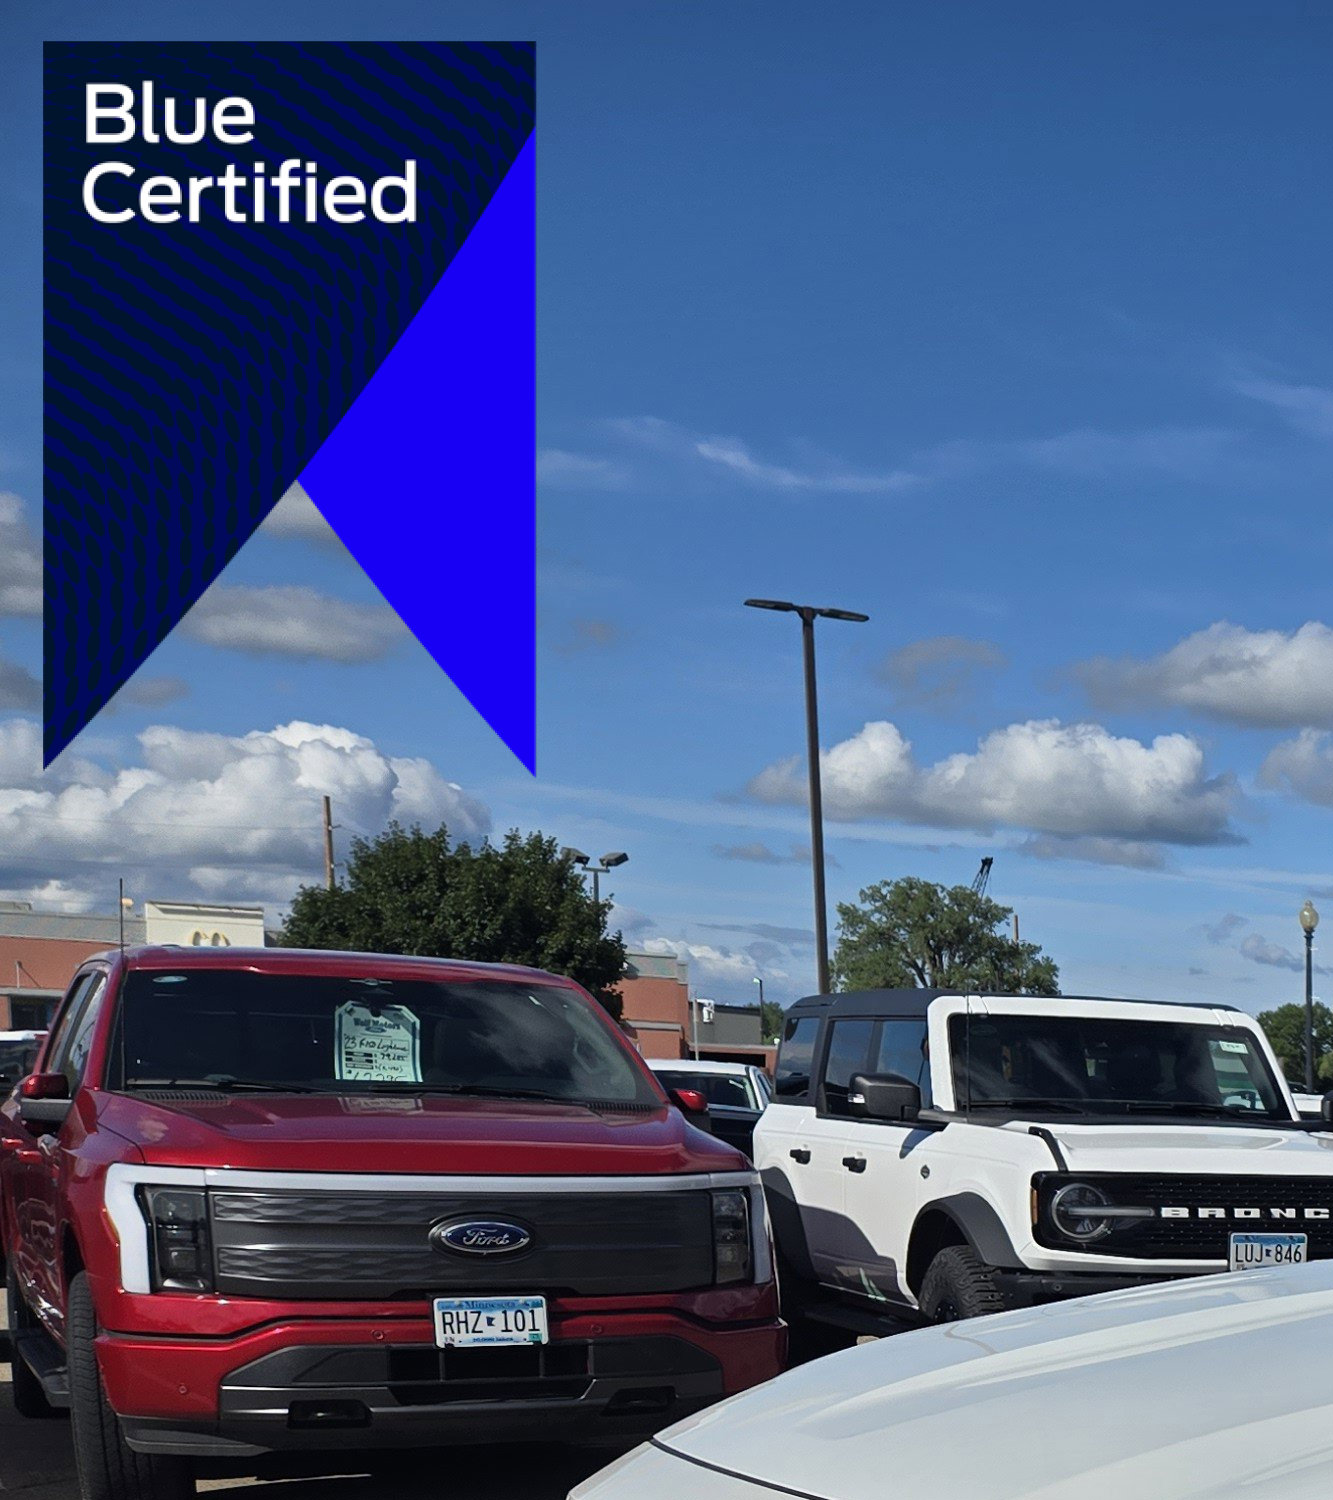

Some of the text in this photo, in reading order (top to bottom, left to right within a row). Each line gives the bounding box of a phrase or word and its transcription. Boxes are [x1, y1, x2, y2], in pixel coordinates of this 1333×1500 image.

[463, 1228, 510, 1245] Ford
[1235, 1244, 1302, 1262] LUJ 846
[441, 1309, 541, 1334] RHZ 101
